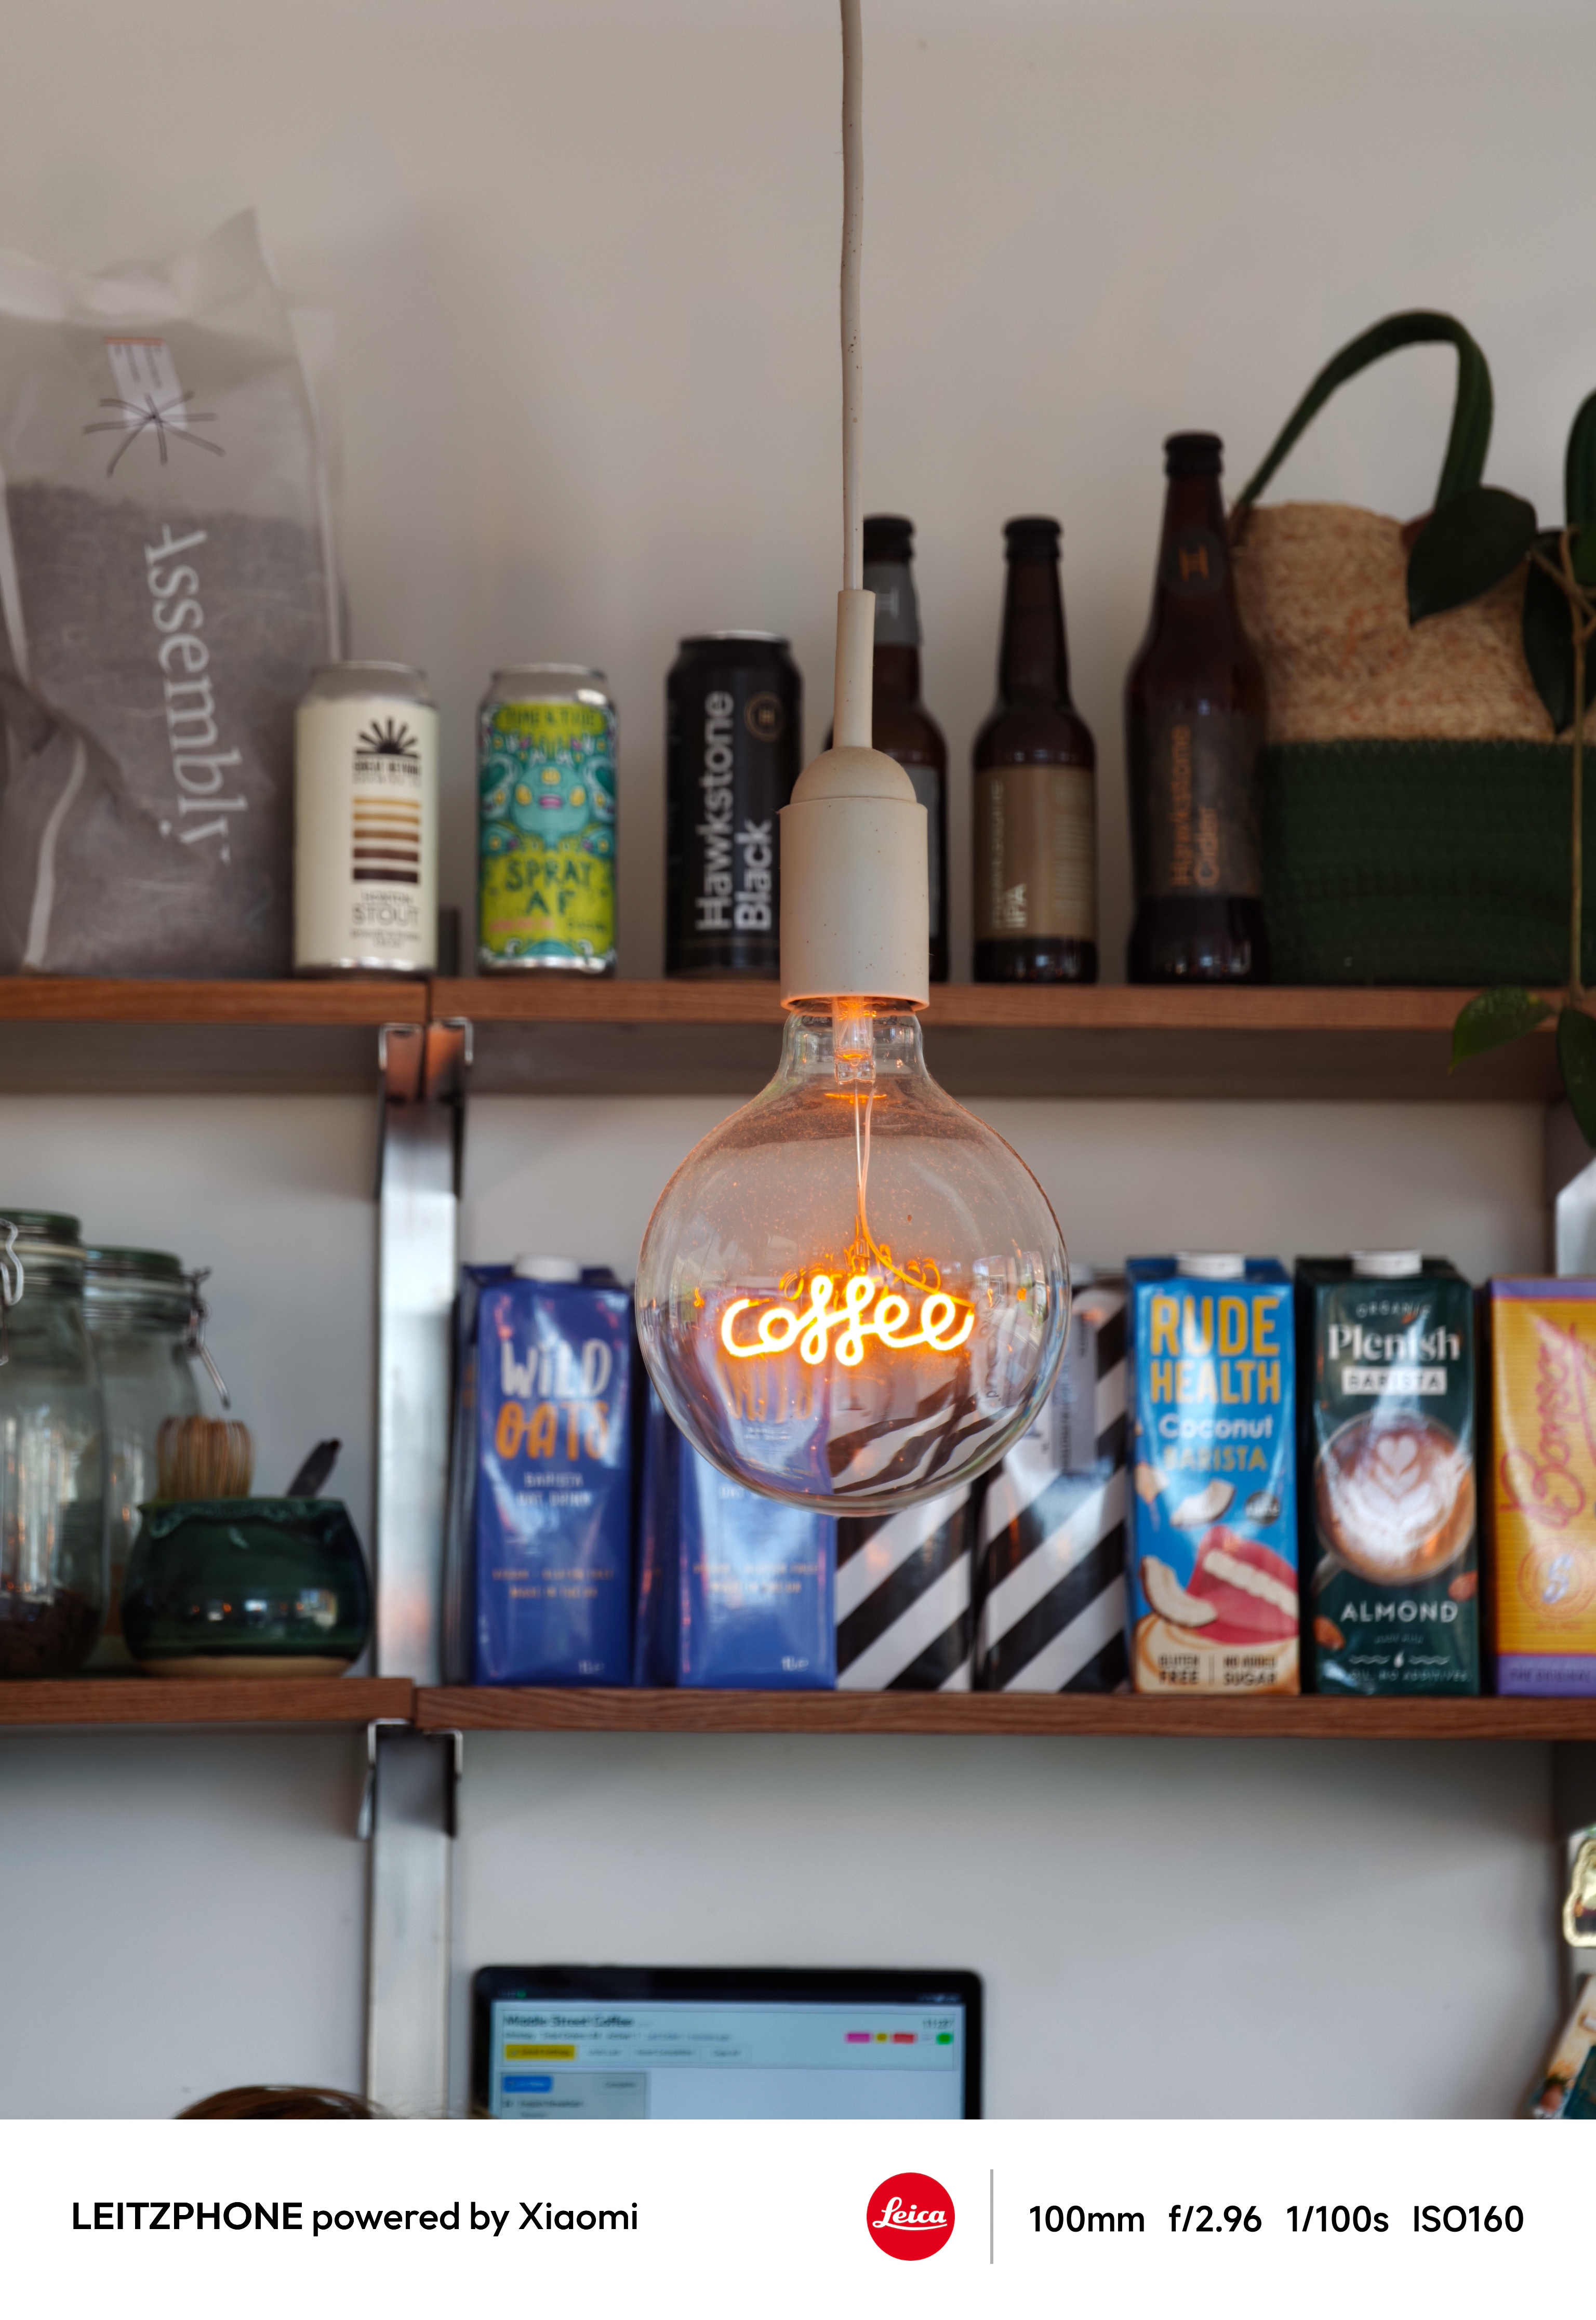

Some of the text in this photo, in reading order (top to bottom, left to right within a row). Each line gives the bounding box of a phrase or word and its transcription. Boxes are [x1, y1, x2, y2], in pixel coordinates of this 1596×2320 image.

[696, 690, 734, 931] Hawkstone
[1193, 805, 1219, 887] Cider
[505, 858, 594, 892] SPRAY
[734, 818, 772, 931] Black
[352, 902, 419, 928] STOUT
[526, 889, 576, 917] AF
[1004, 883, 1027, 928] IPA
[721, 1274, 976, 1367] coffee
[1150, 1296, 1280, 1357] RUDE
[1355, 1300, 1431, 1318] ORGANIC
[1327, 1323, 1462, 1362] Plenish
[1150, 1359, 1281, 1406] HEALTH
[495, 1401, 610, 1462] OATS
[1159, 1412, 1273, 1440] Coconut
[1163, 1445, 1268, 1472] BARISTA
[1340, 1599, 1458, 1623] ALMOND
[1159, 1670, 1199, 1685] FREE
[1223, 1672, 1278, 1686] SUGAR
